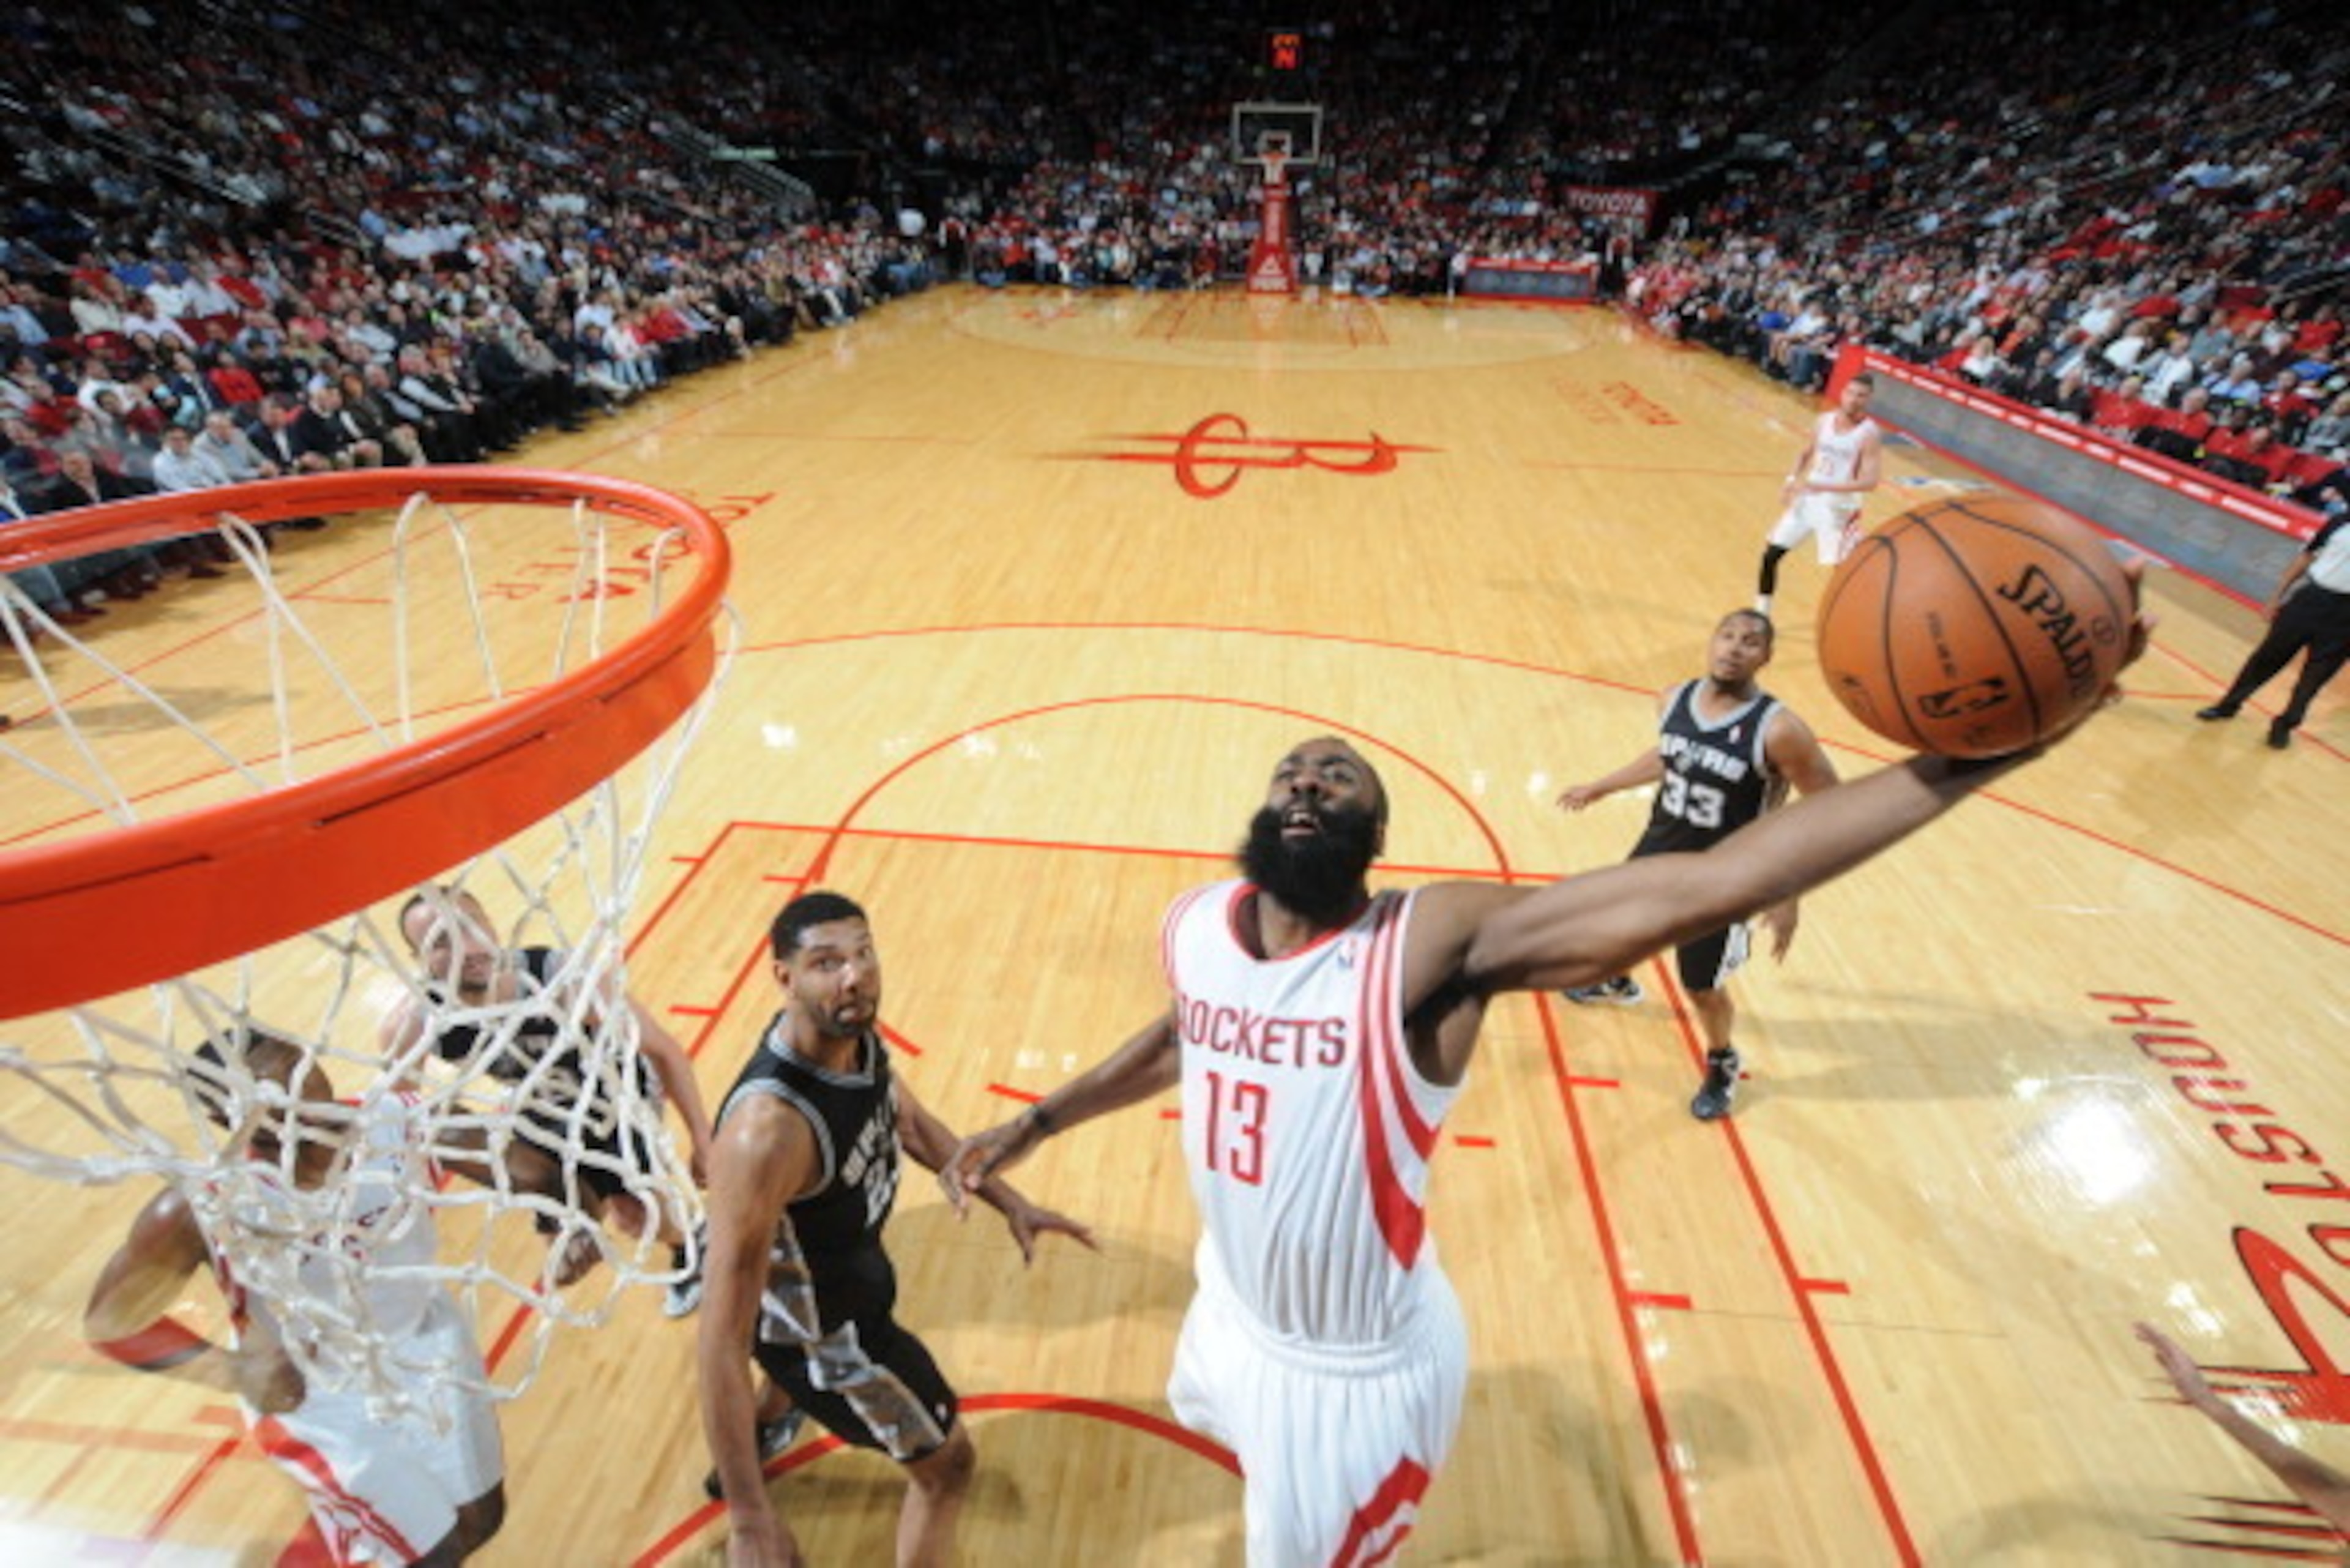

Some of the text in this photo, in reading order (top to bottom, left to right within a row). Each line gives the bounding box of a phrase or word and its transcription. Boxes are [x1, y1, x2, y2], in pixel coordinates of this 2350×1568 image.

[1569, 191, 1647, 213] TOYOTA
[1662, 769, 1726, 828] 33
[1206, 1070, 1268, 1187] 13
